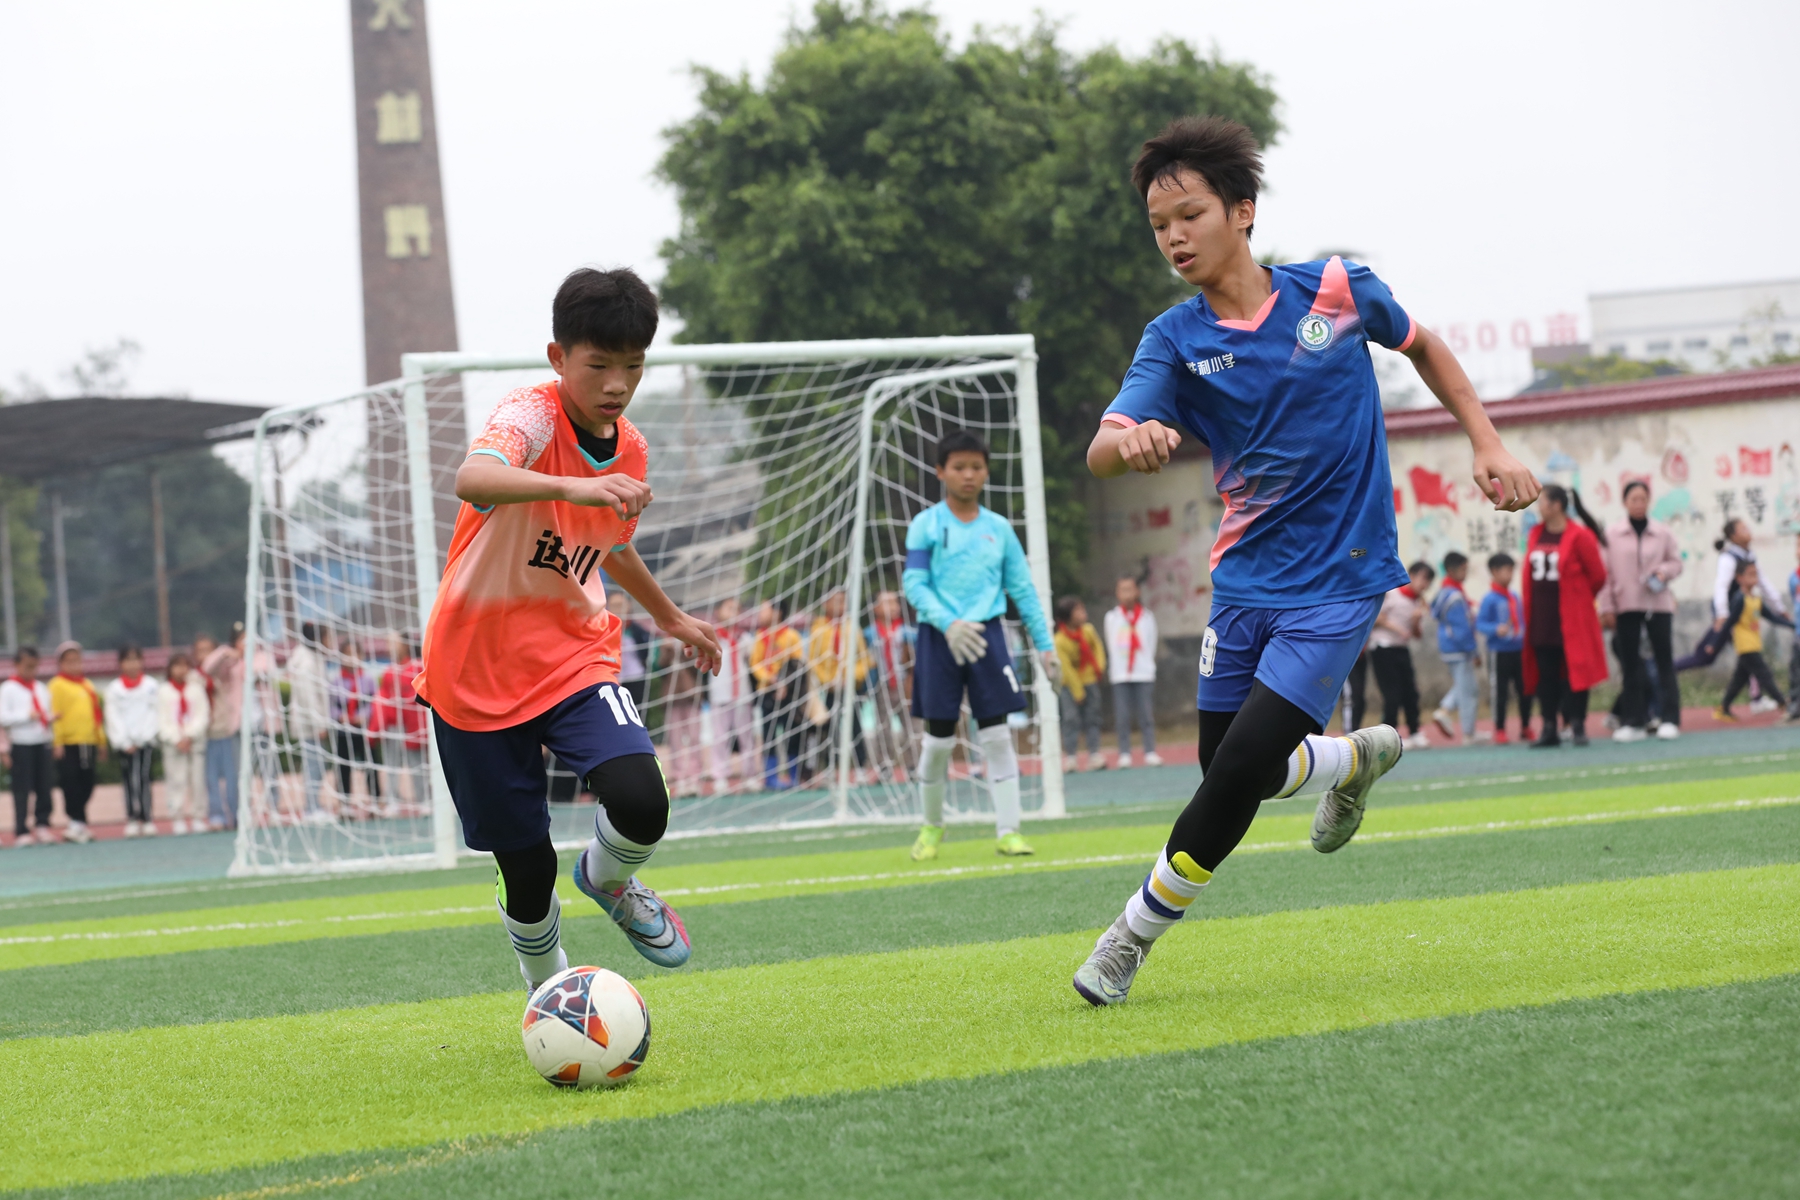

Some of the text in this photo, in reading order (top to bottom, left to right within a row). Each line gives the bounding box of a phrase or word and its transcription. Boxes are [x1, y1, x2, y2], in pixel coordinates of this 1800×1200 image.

[1431, 311, 1578, 354] 500亩
[1003, 664, 1019, 693] 1
[598, 685, 645, 728] 10
